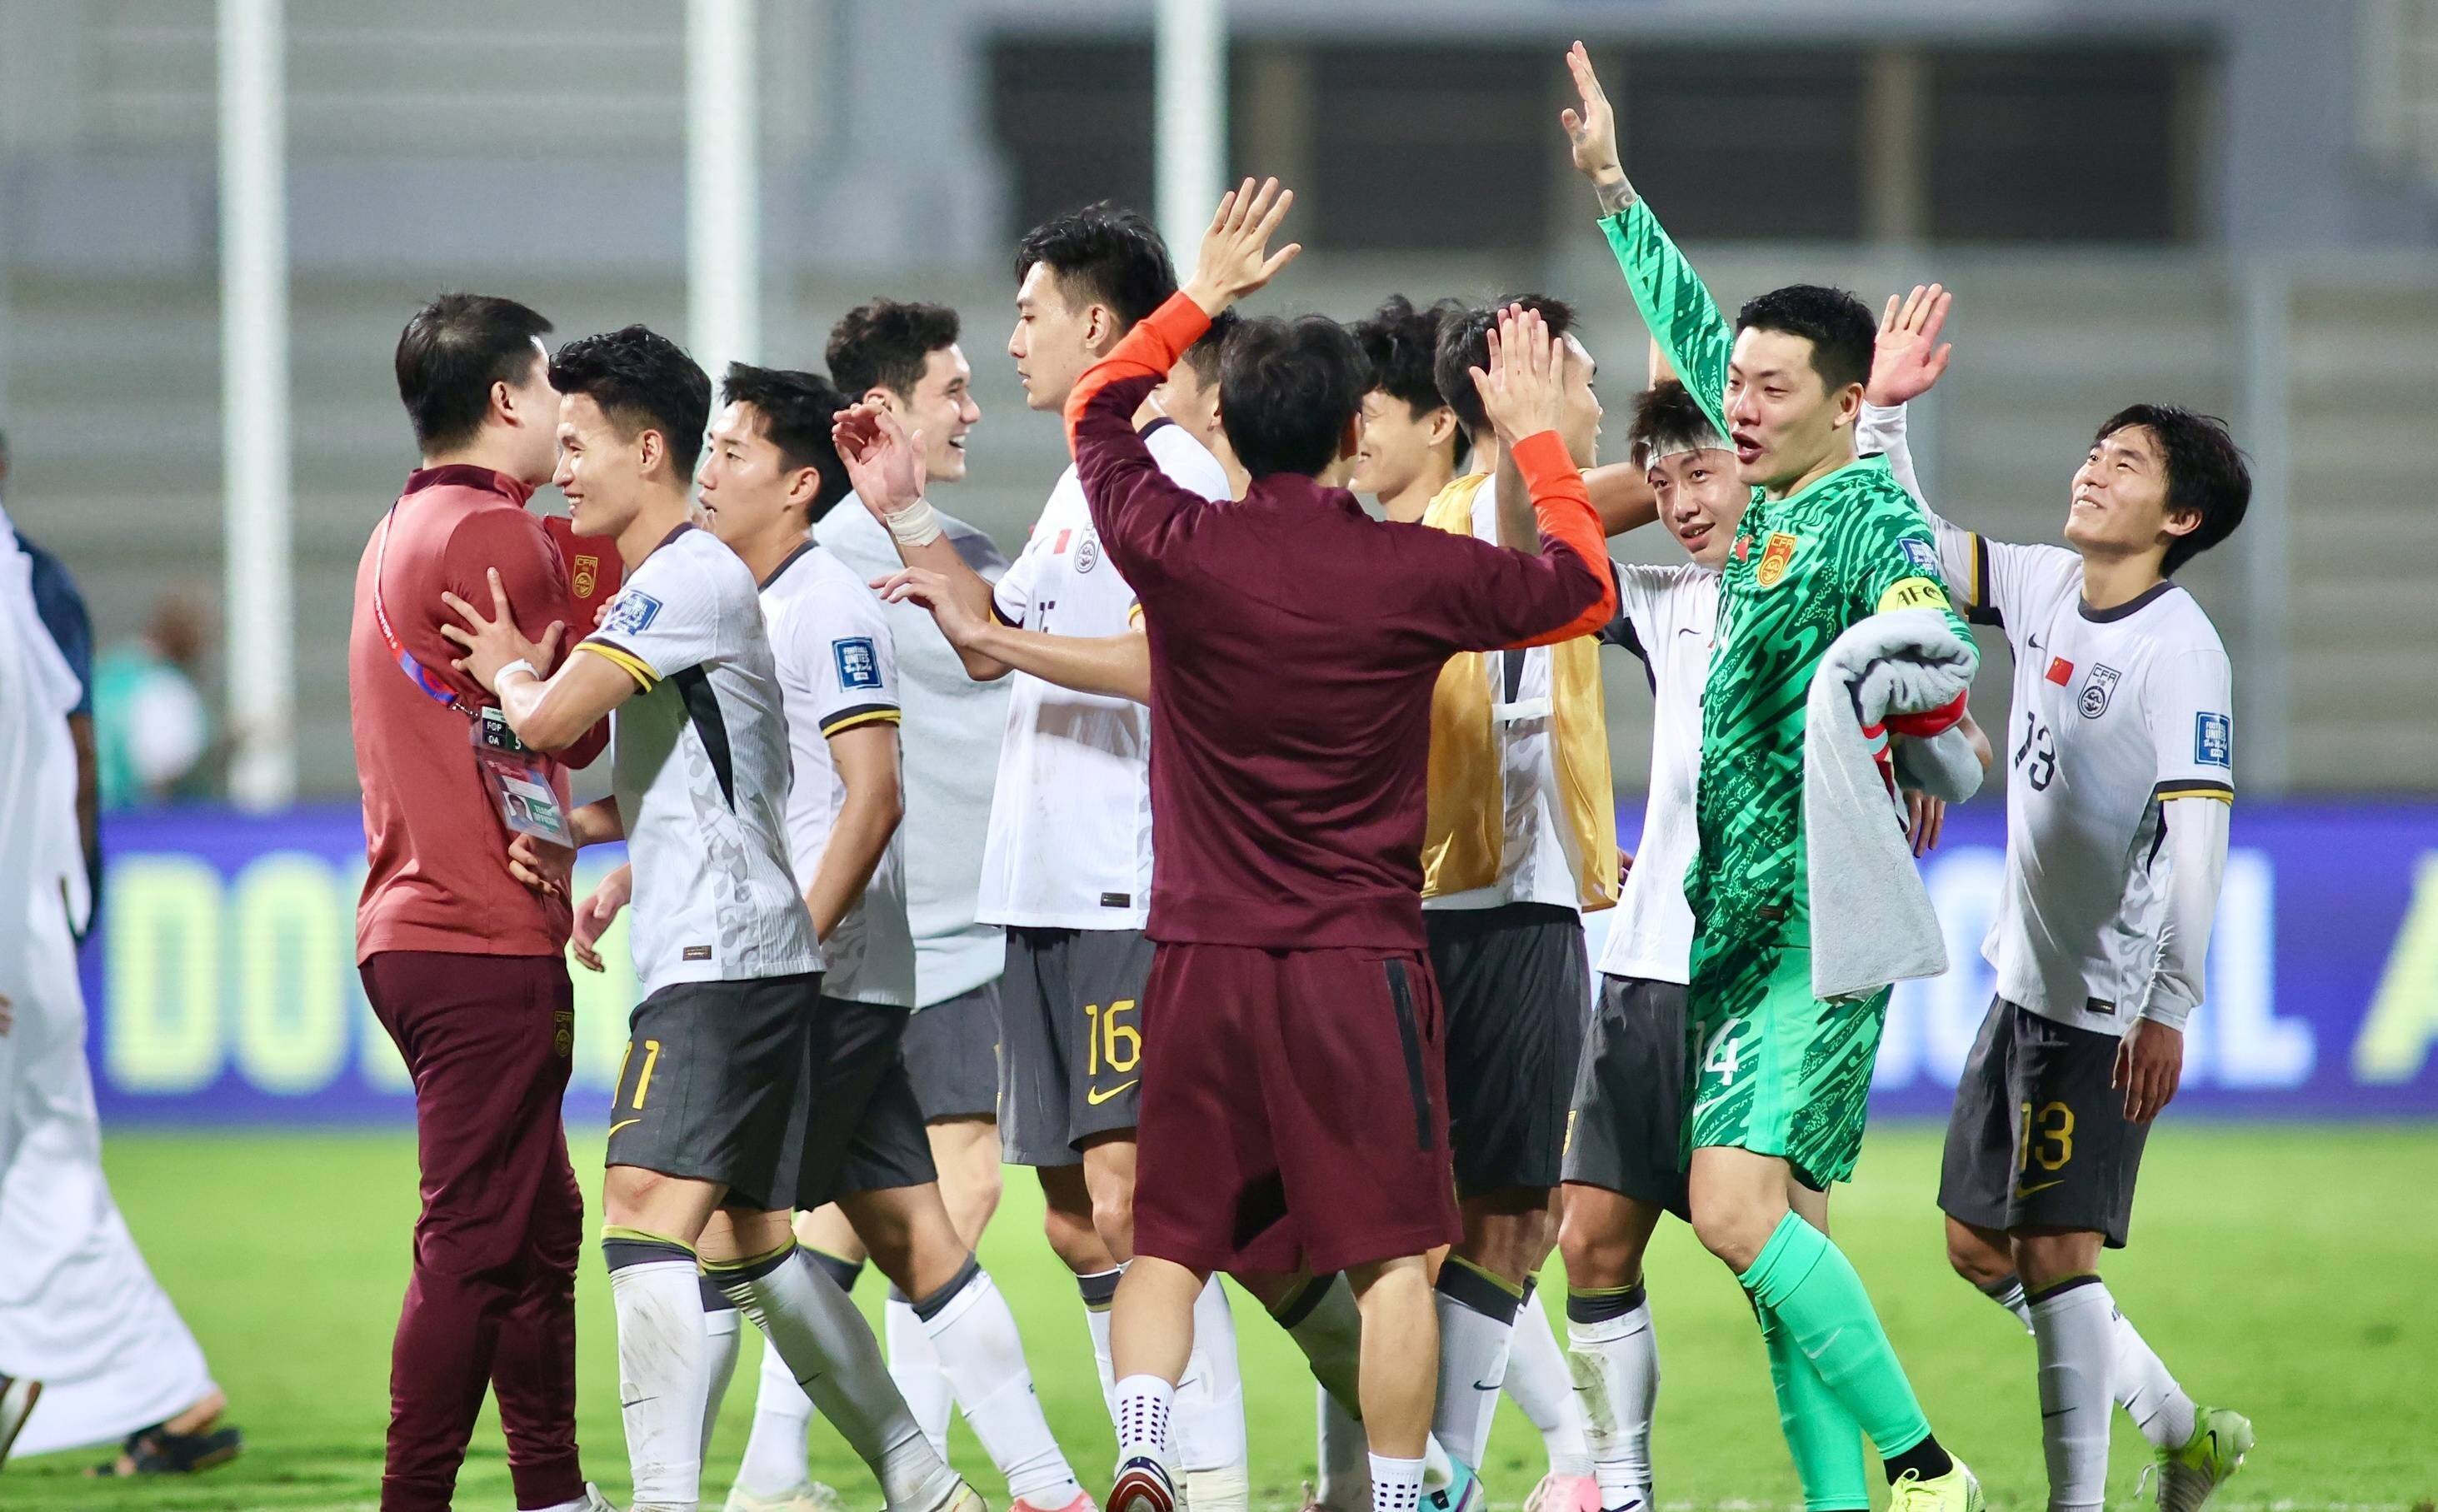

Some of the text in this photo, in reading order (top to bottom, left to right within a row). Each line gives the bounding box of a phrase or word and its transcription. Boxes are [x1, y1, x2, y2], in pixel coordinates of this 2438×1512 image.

[1771, 535, 1794, 549] CFA
[577, 557, 597, 568] CFA
[845, 654, 870, 664] UNITES
[2093, 666, 2117, 683] CFA
[487, 720, 502, 733] FOP
[1085, 999, 1142, 1074] 16
[2020, 1100, 2075, 1171] 13
